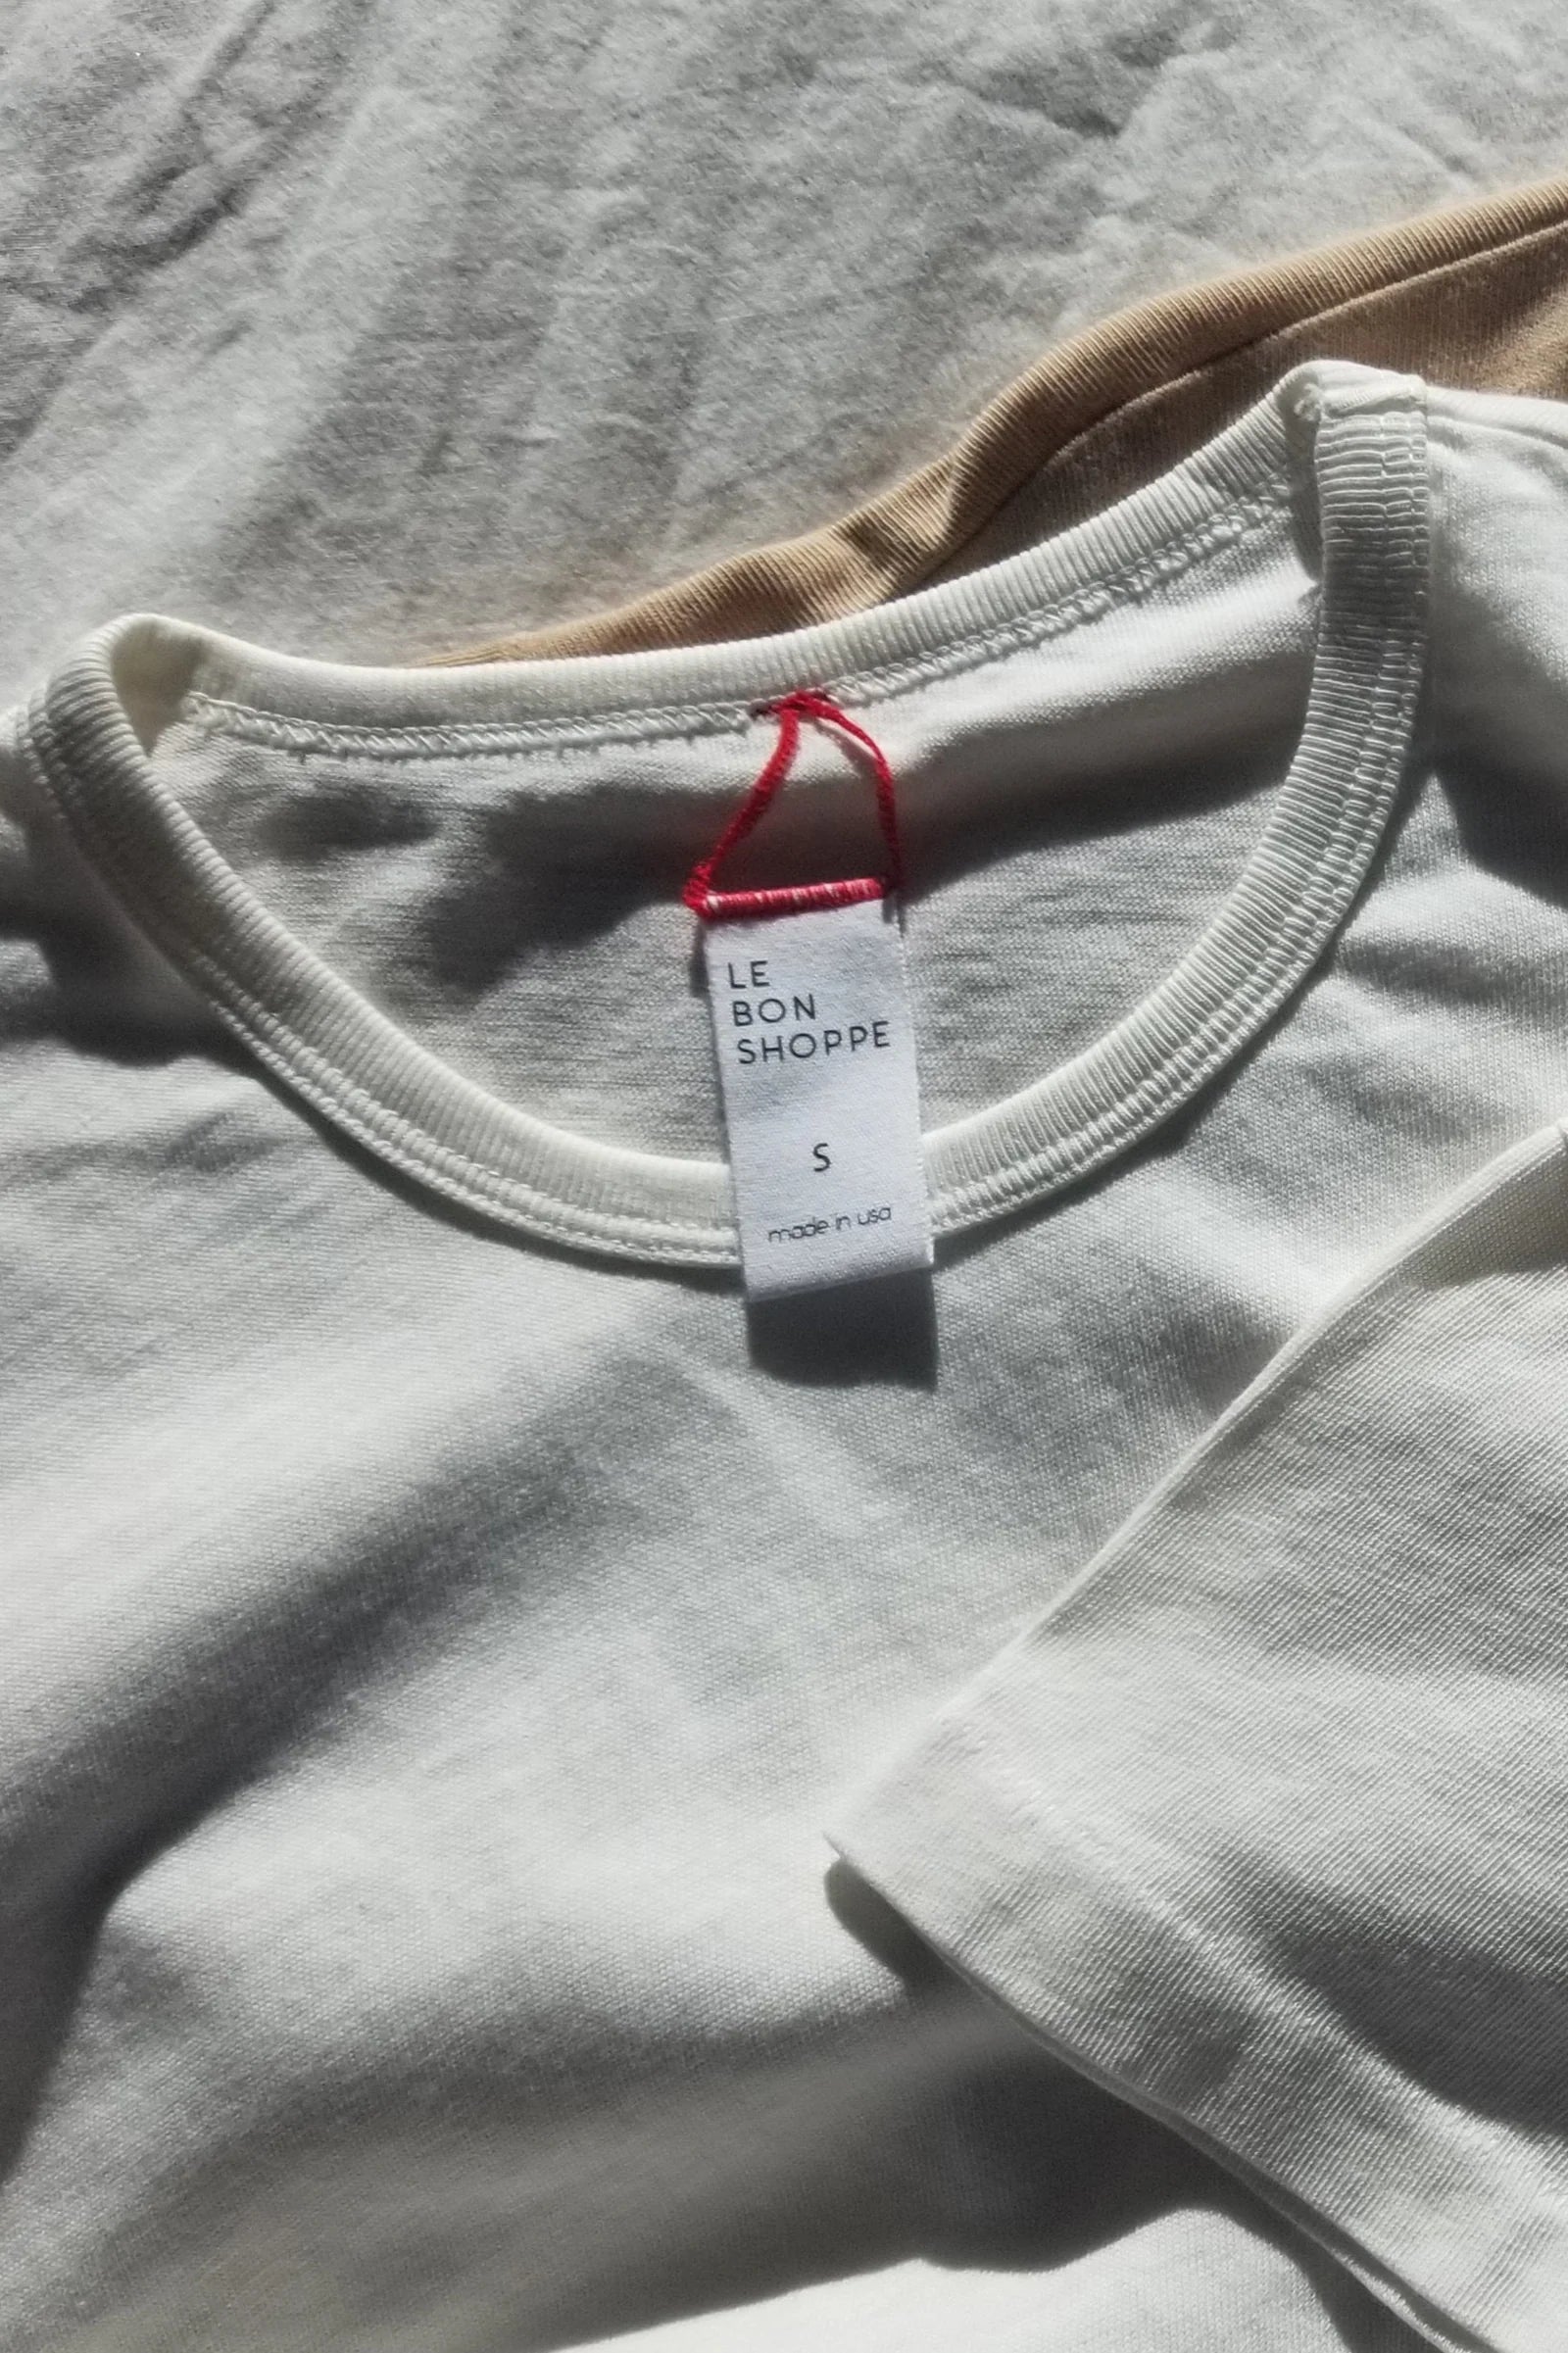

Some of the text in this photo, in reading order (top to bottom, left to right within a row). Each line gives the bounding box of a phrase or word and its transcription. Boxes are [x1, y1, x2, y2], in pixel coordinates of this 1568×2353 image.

[727, 959, 770, 990] LE
[732, 993, 816, 1027] BON
[736, 1020, 892, 1065] SHOPPE
[811, 1142, 833, 1173] S
[767, 1206, 893, 1243] made in usa
